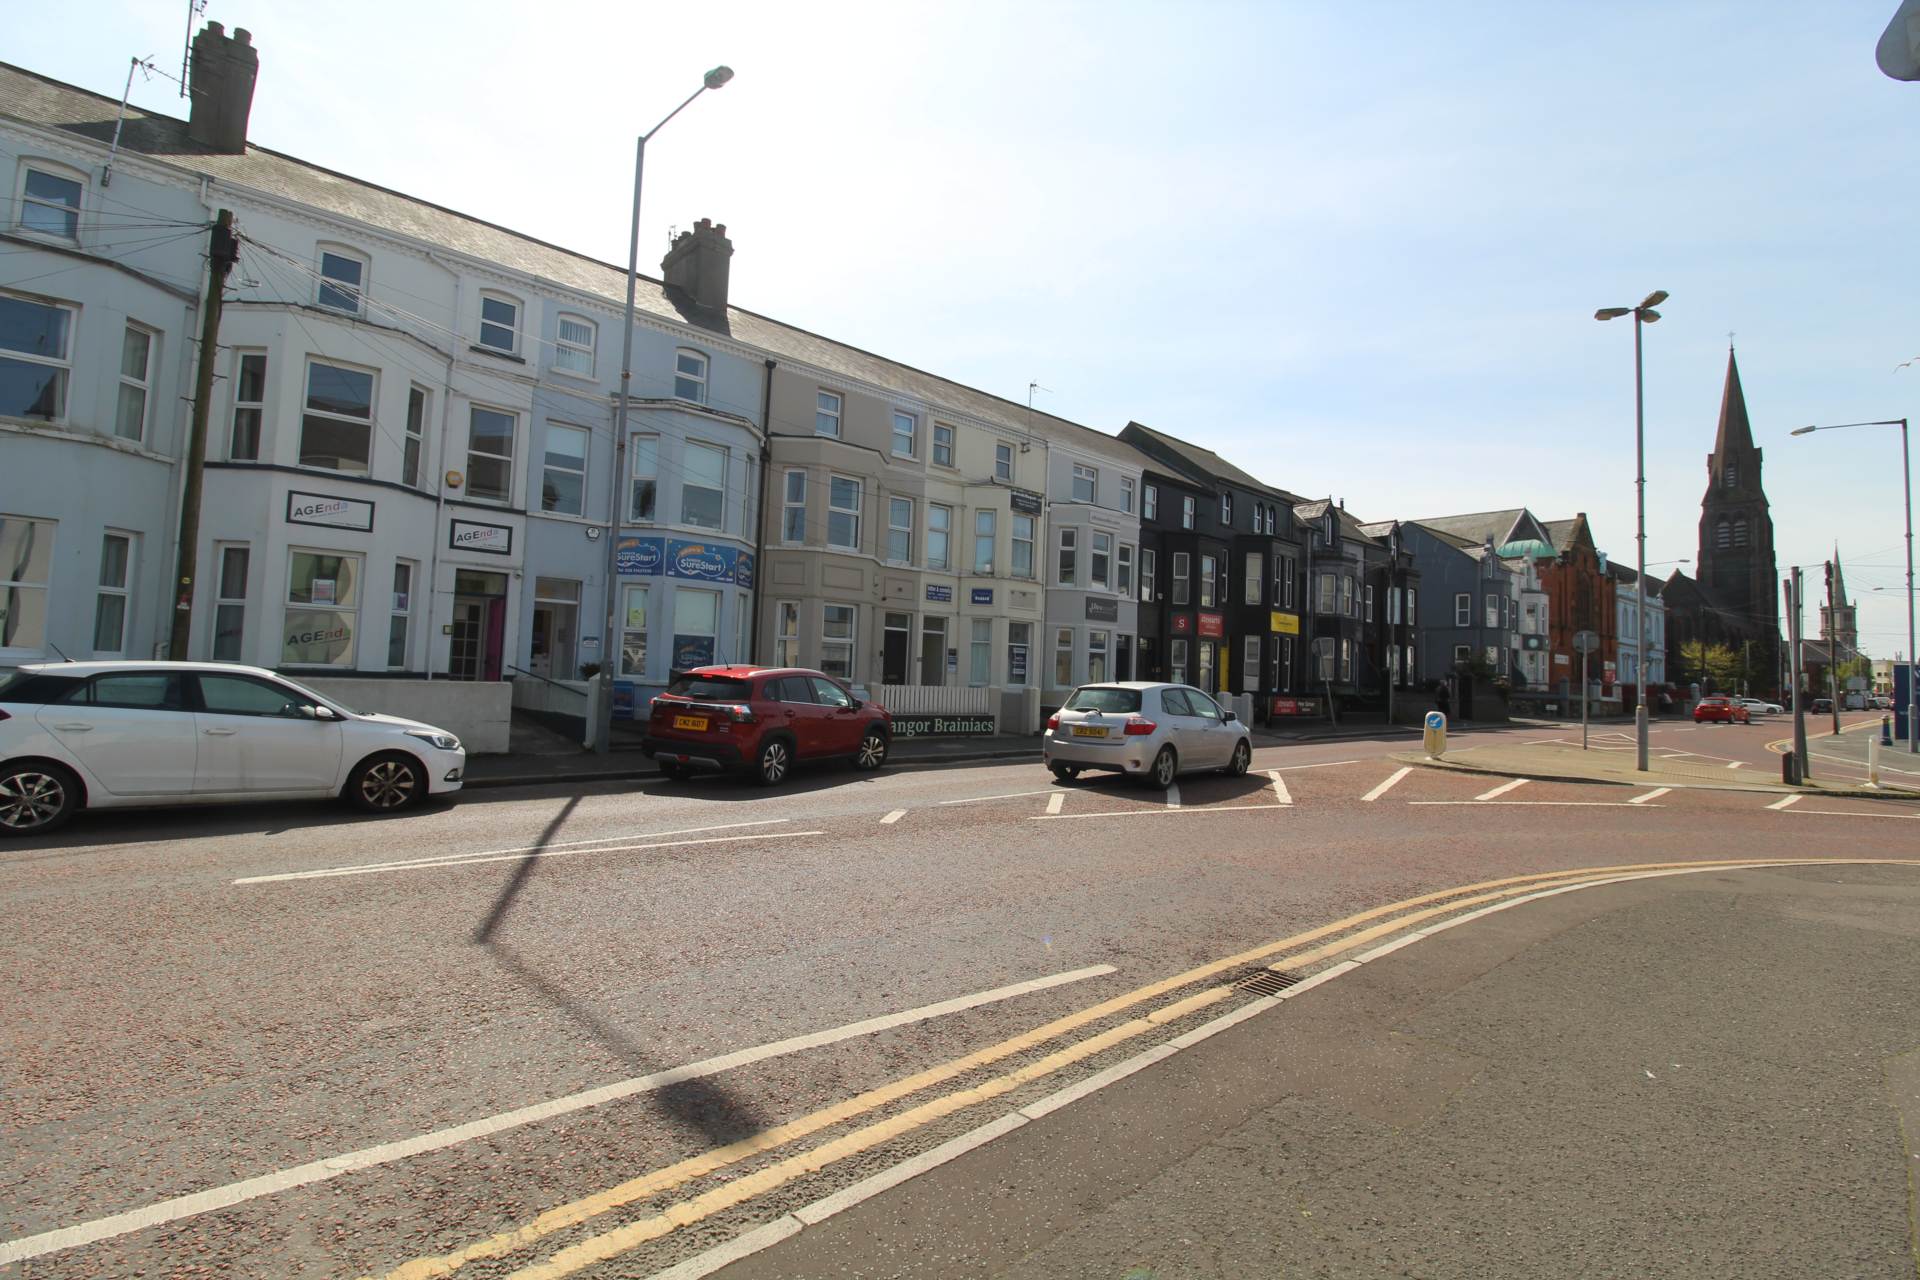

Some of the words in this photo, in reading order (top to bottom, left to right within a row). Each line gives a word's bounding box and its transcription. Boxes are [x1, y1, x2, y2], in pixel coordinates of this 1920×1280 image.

[616, 552, 657, 562] SureStart
[680, 559, 721, 572] SureStart
[1178, 618, 1185, 628] S
[890, 720, 930, 736] angor
[934, 717, 994, 733] Brainiacs
